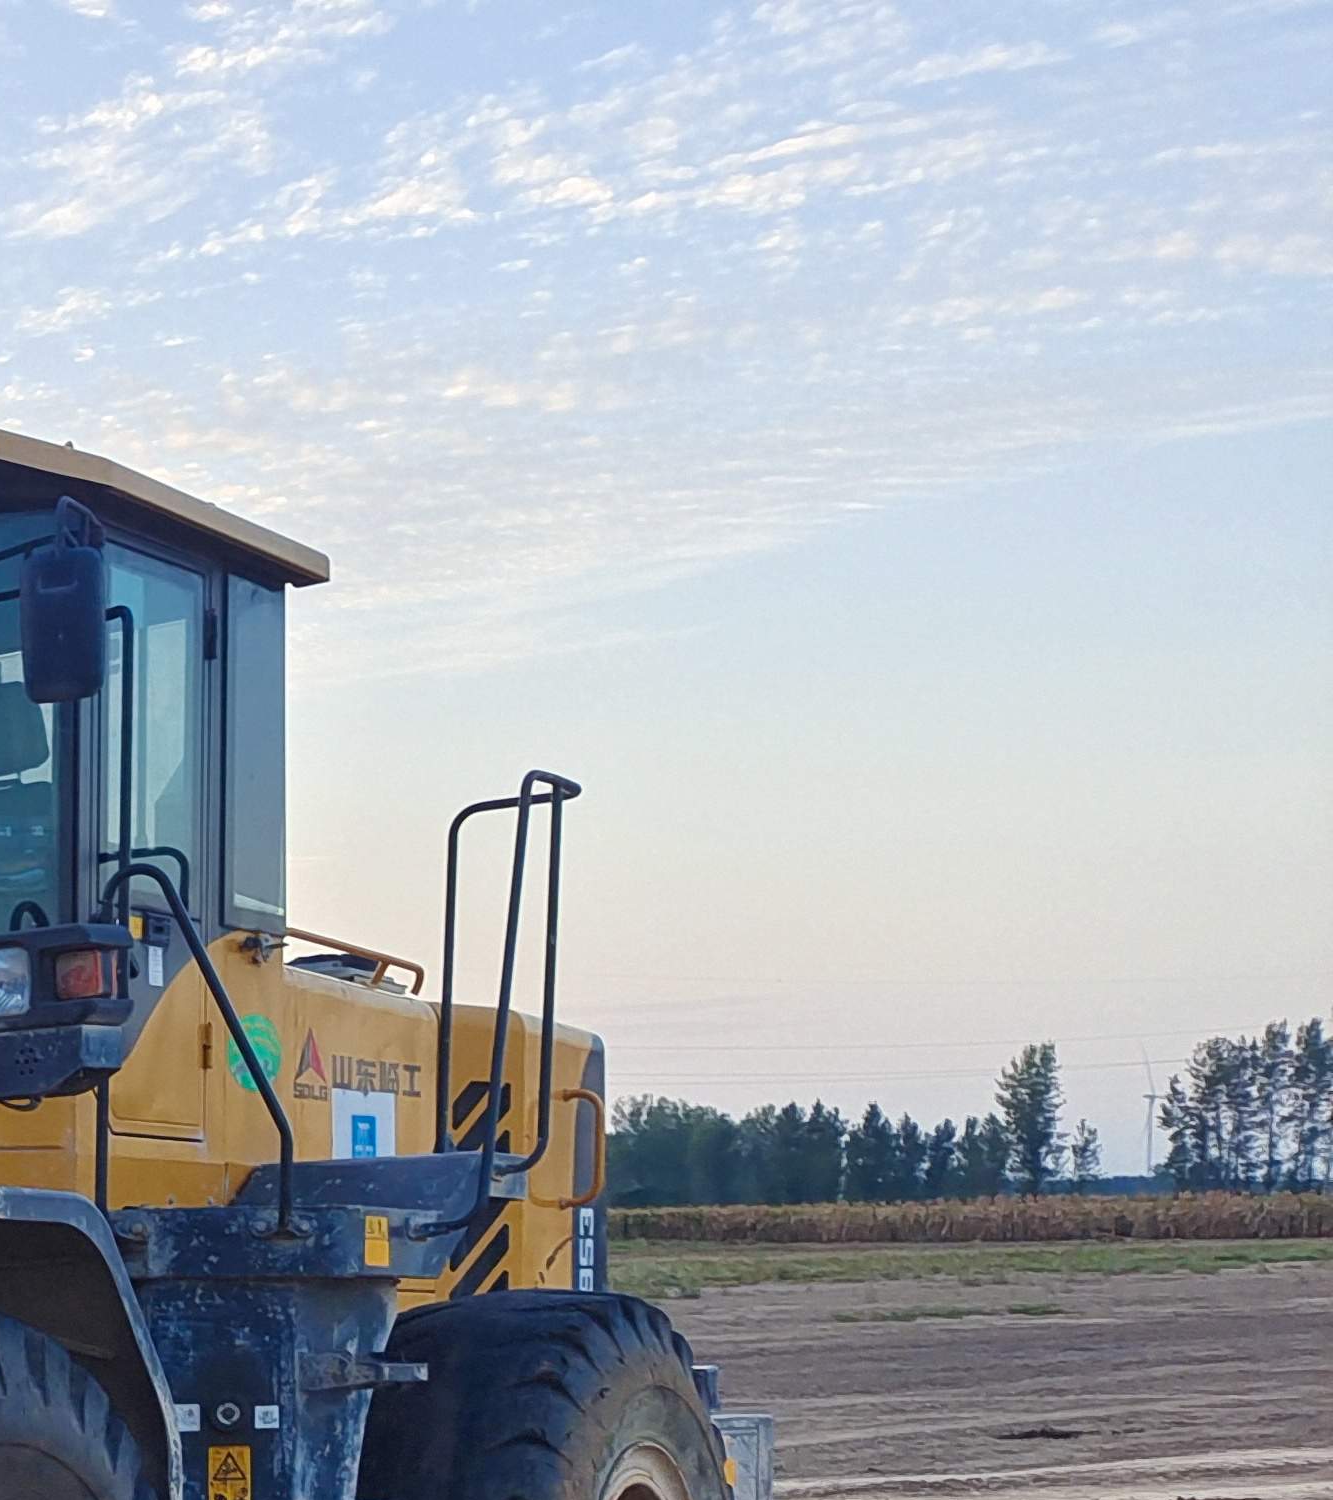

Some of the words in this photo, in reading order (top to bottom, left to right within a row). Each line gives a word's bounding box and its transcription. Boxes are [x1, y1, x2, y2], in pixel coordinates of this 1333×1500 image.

[331, 1053, 422, 1098] 山东临工
[293, 1082, 328, 1102] SDLG
